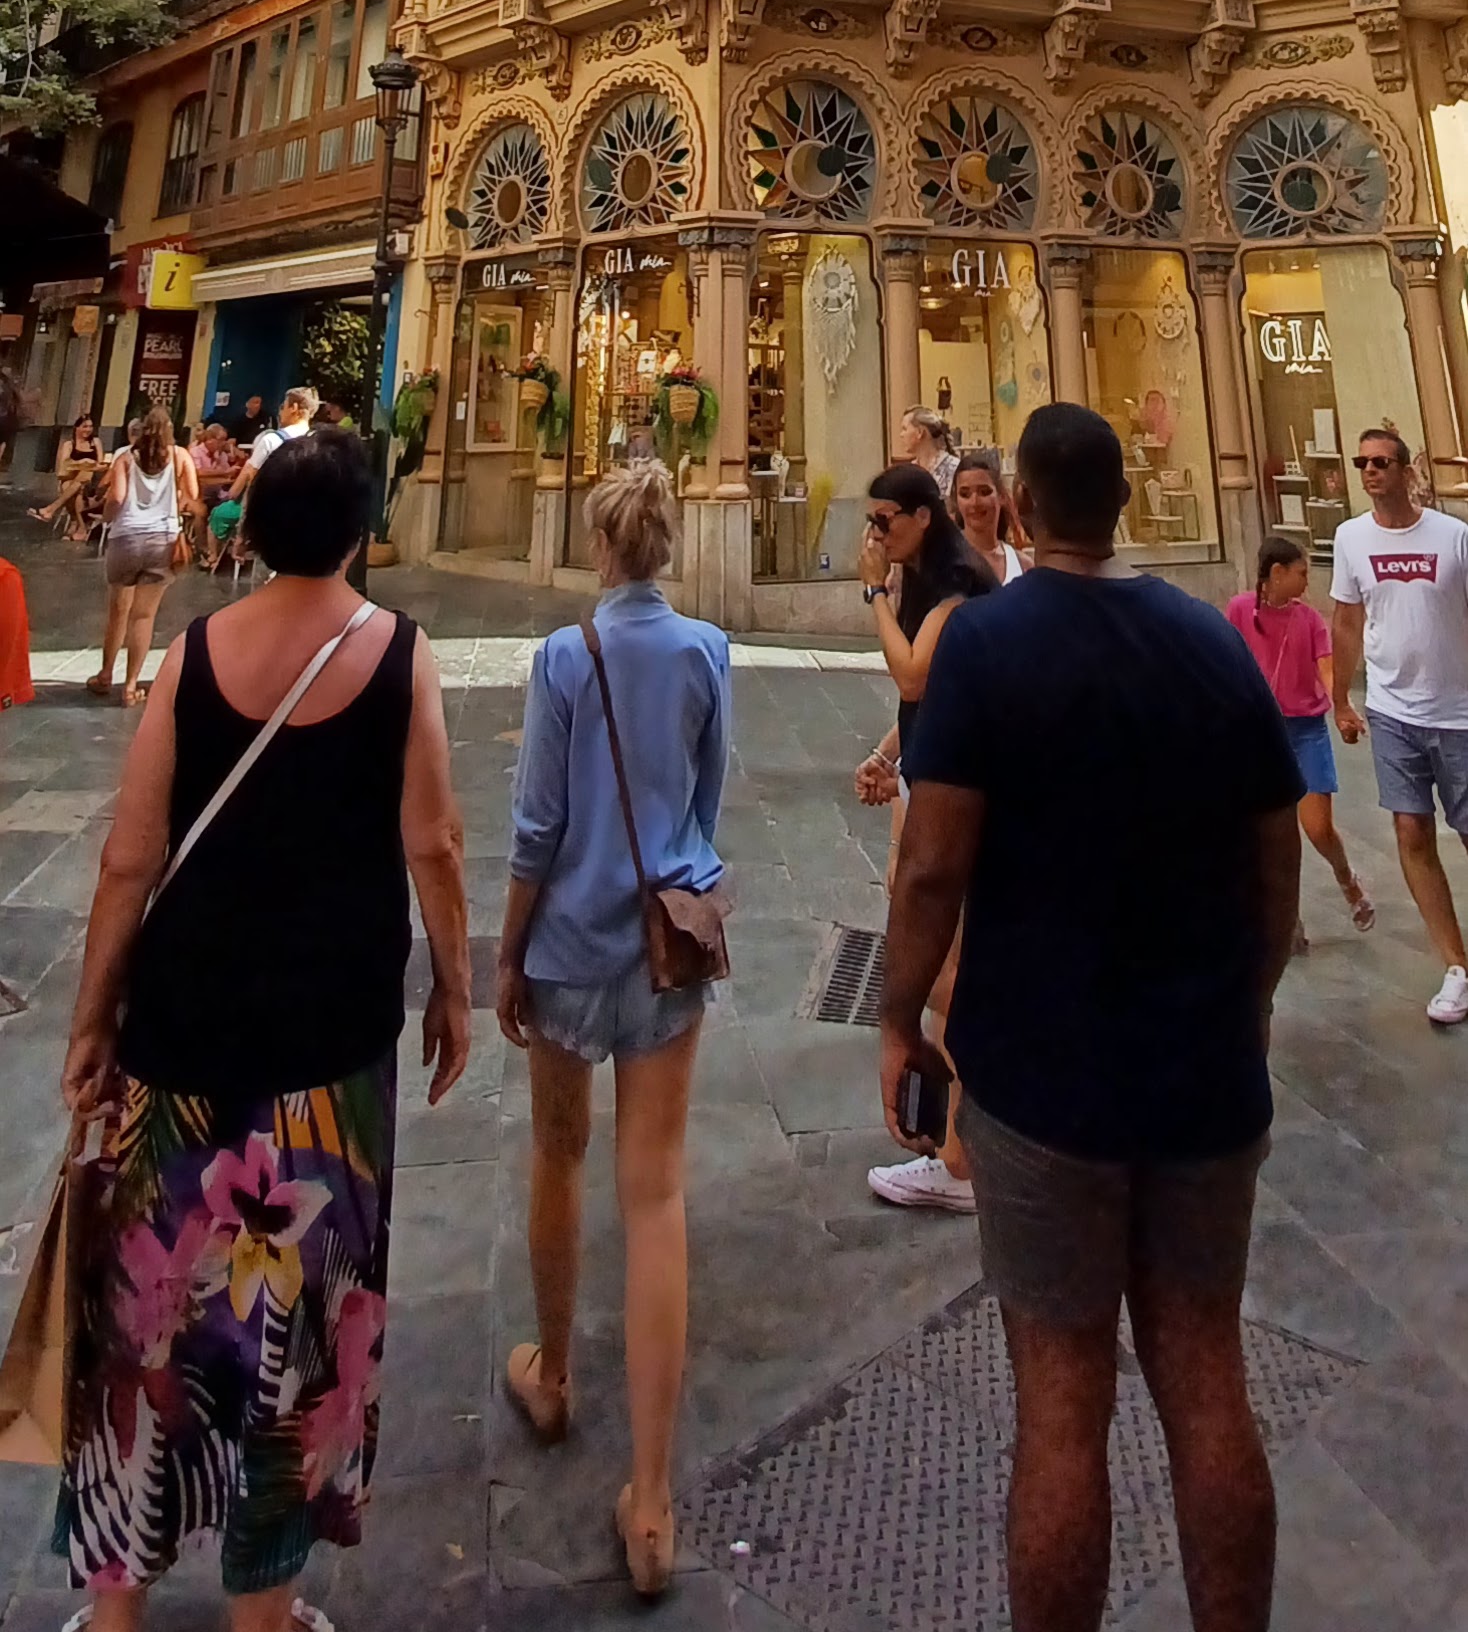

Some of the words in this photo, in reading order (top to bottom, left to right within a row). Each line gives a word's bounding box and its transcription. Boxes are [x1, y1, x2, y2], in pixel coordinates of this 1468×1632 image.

[482, 263, 506, 287] GIA
[604, 248, 634, 274] GIA
[952, 249, 1011, 288] GIA
[164, 262, 180, 292] i
[1260, 319, 1332, 362] GIA
[139, 380, 179, 396] FREE
